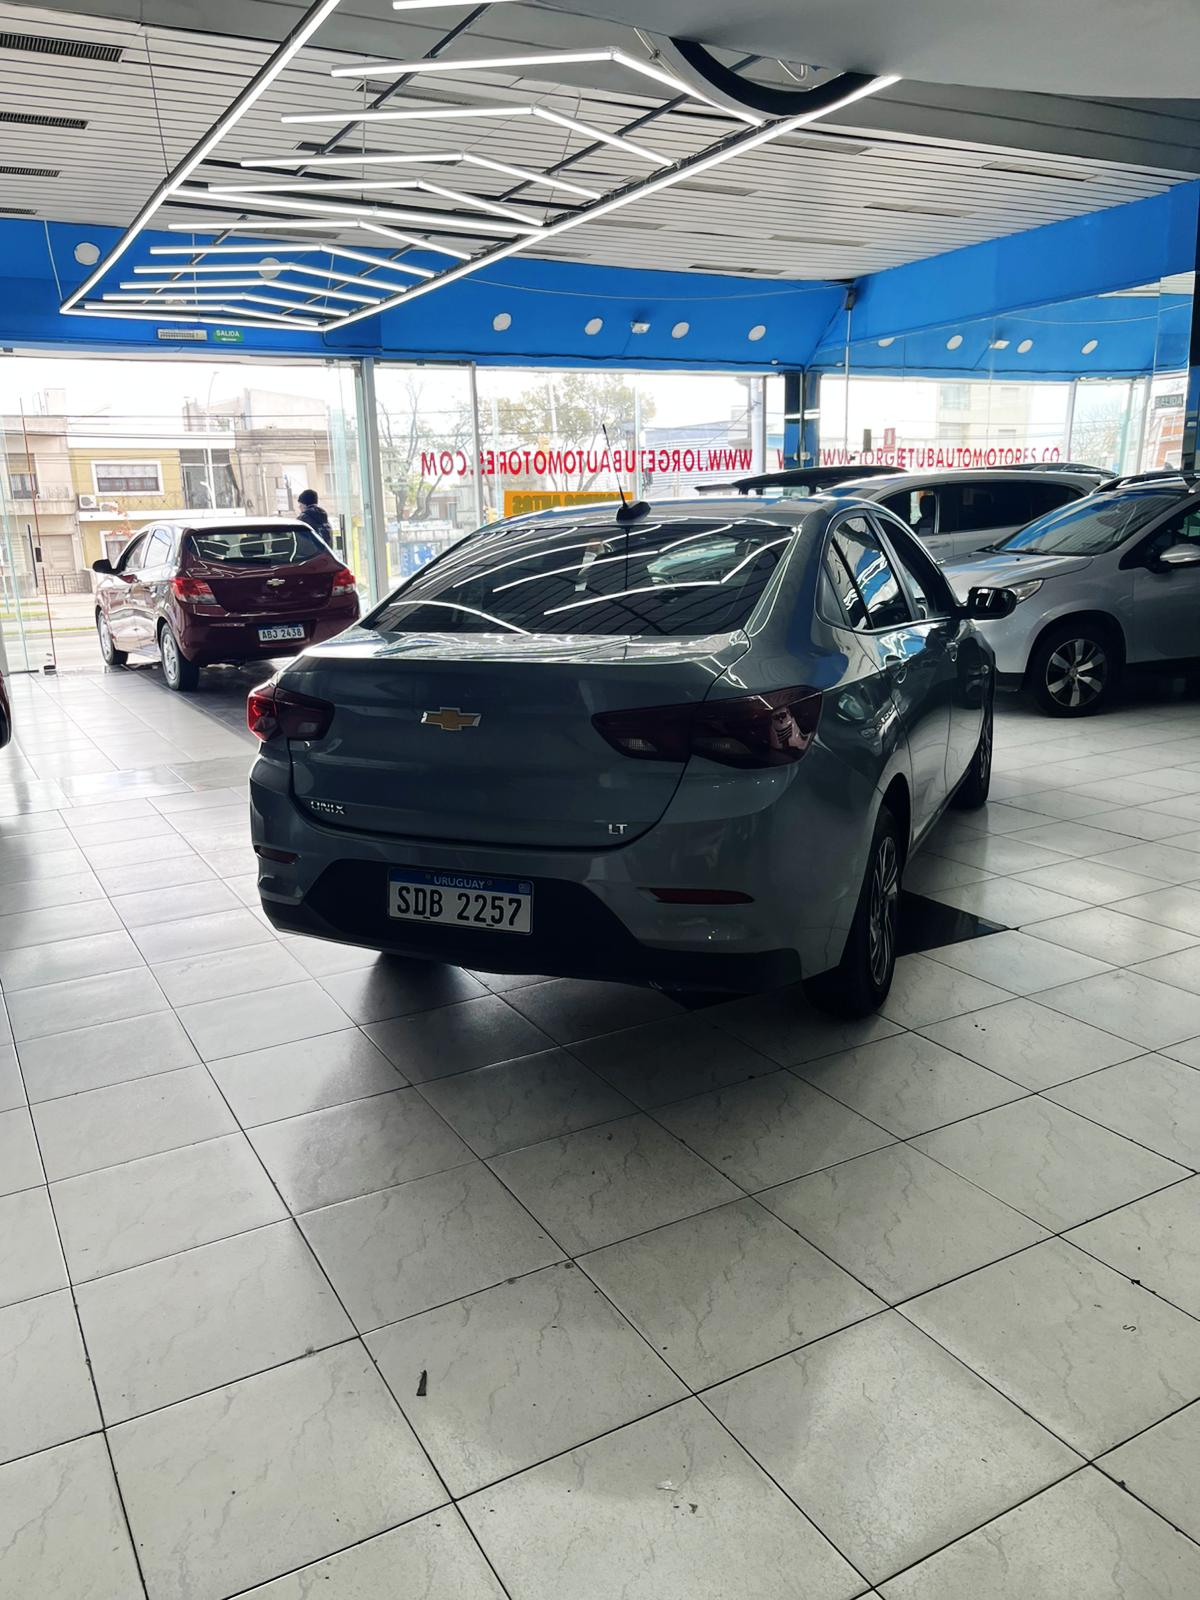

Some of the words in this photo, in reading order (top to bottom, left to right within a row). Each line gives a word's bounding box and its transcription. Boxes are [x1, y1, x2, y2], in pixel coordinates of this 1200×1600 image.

[310, 800, 345, 815] ONIX
[608, 823, 628, 835] LT
[433, 875, 486, 889] URUGUAY
[397, 885, 443, 917] SDB
[457, 892, 522, 926] 2257
